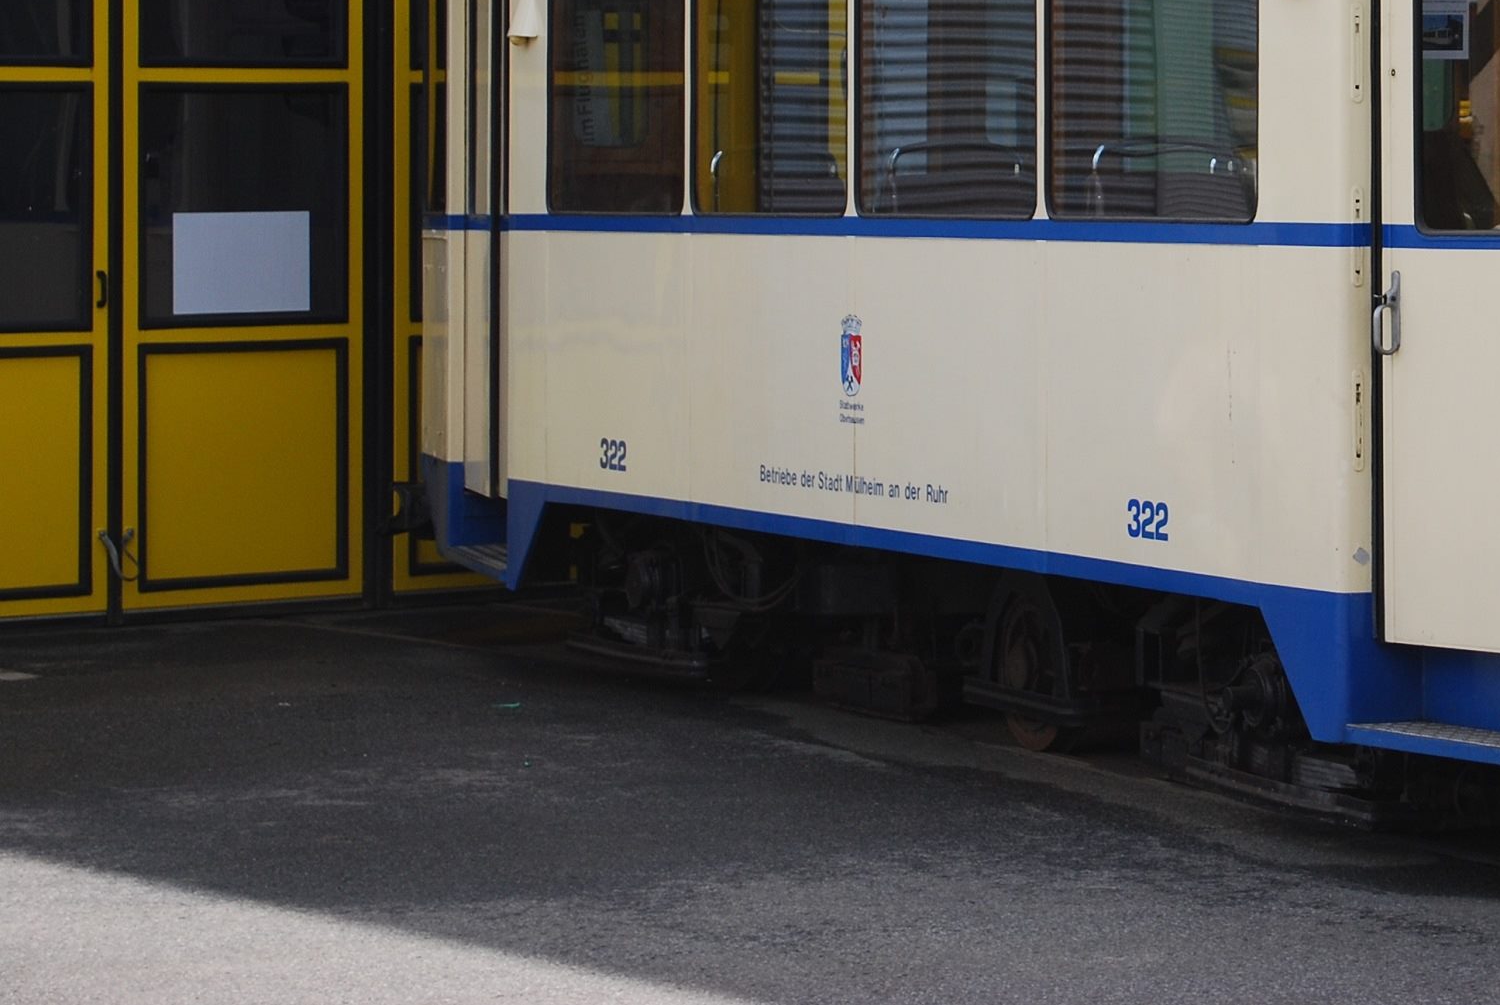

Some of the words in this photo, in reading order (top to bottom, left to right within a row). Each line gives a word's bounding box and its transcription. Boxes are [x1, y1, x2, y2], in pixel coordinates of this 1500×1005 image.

[600, 437, 626, 472] 322
[759, 464, 797, 486] Betriebe
[800, 469, 815, 488] der
[818, 471, 843, 492] Stadt
[845, 475, 884, 496] Mülheim
[888, 483, 900, 498] an
[904, 481, 921, 500] der
[926, 483, 948, 503] Ruhr
[1127, 498, 1169, 542] 322
